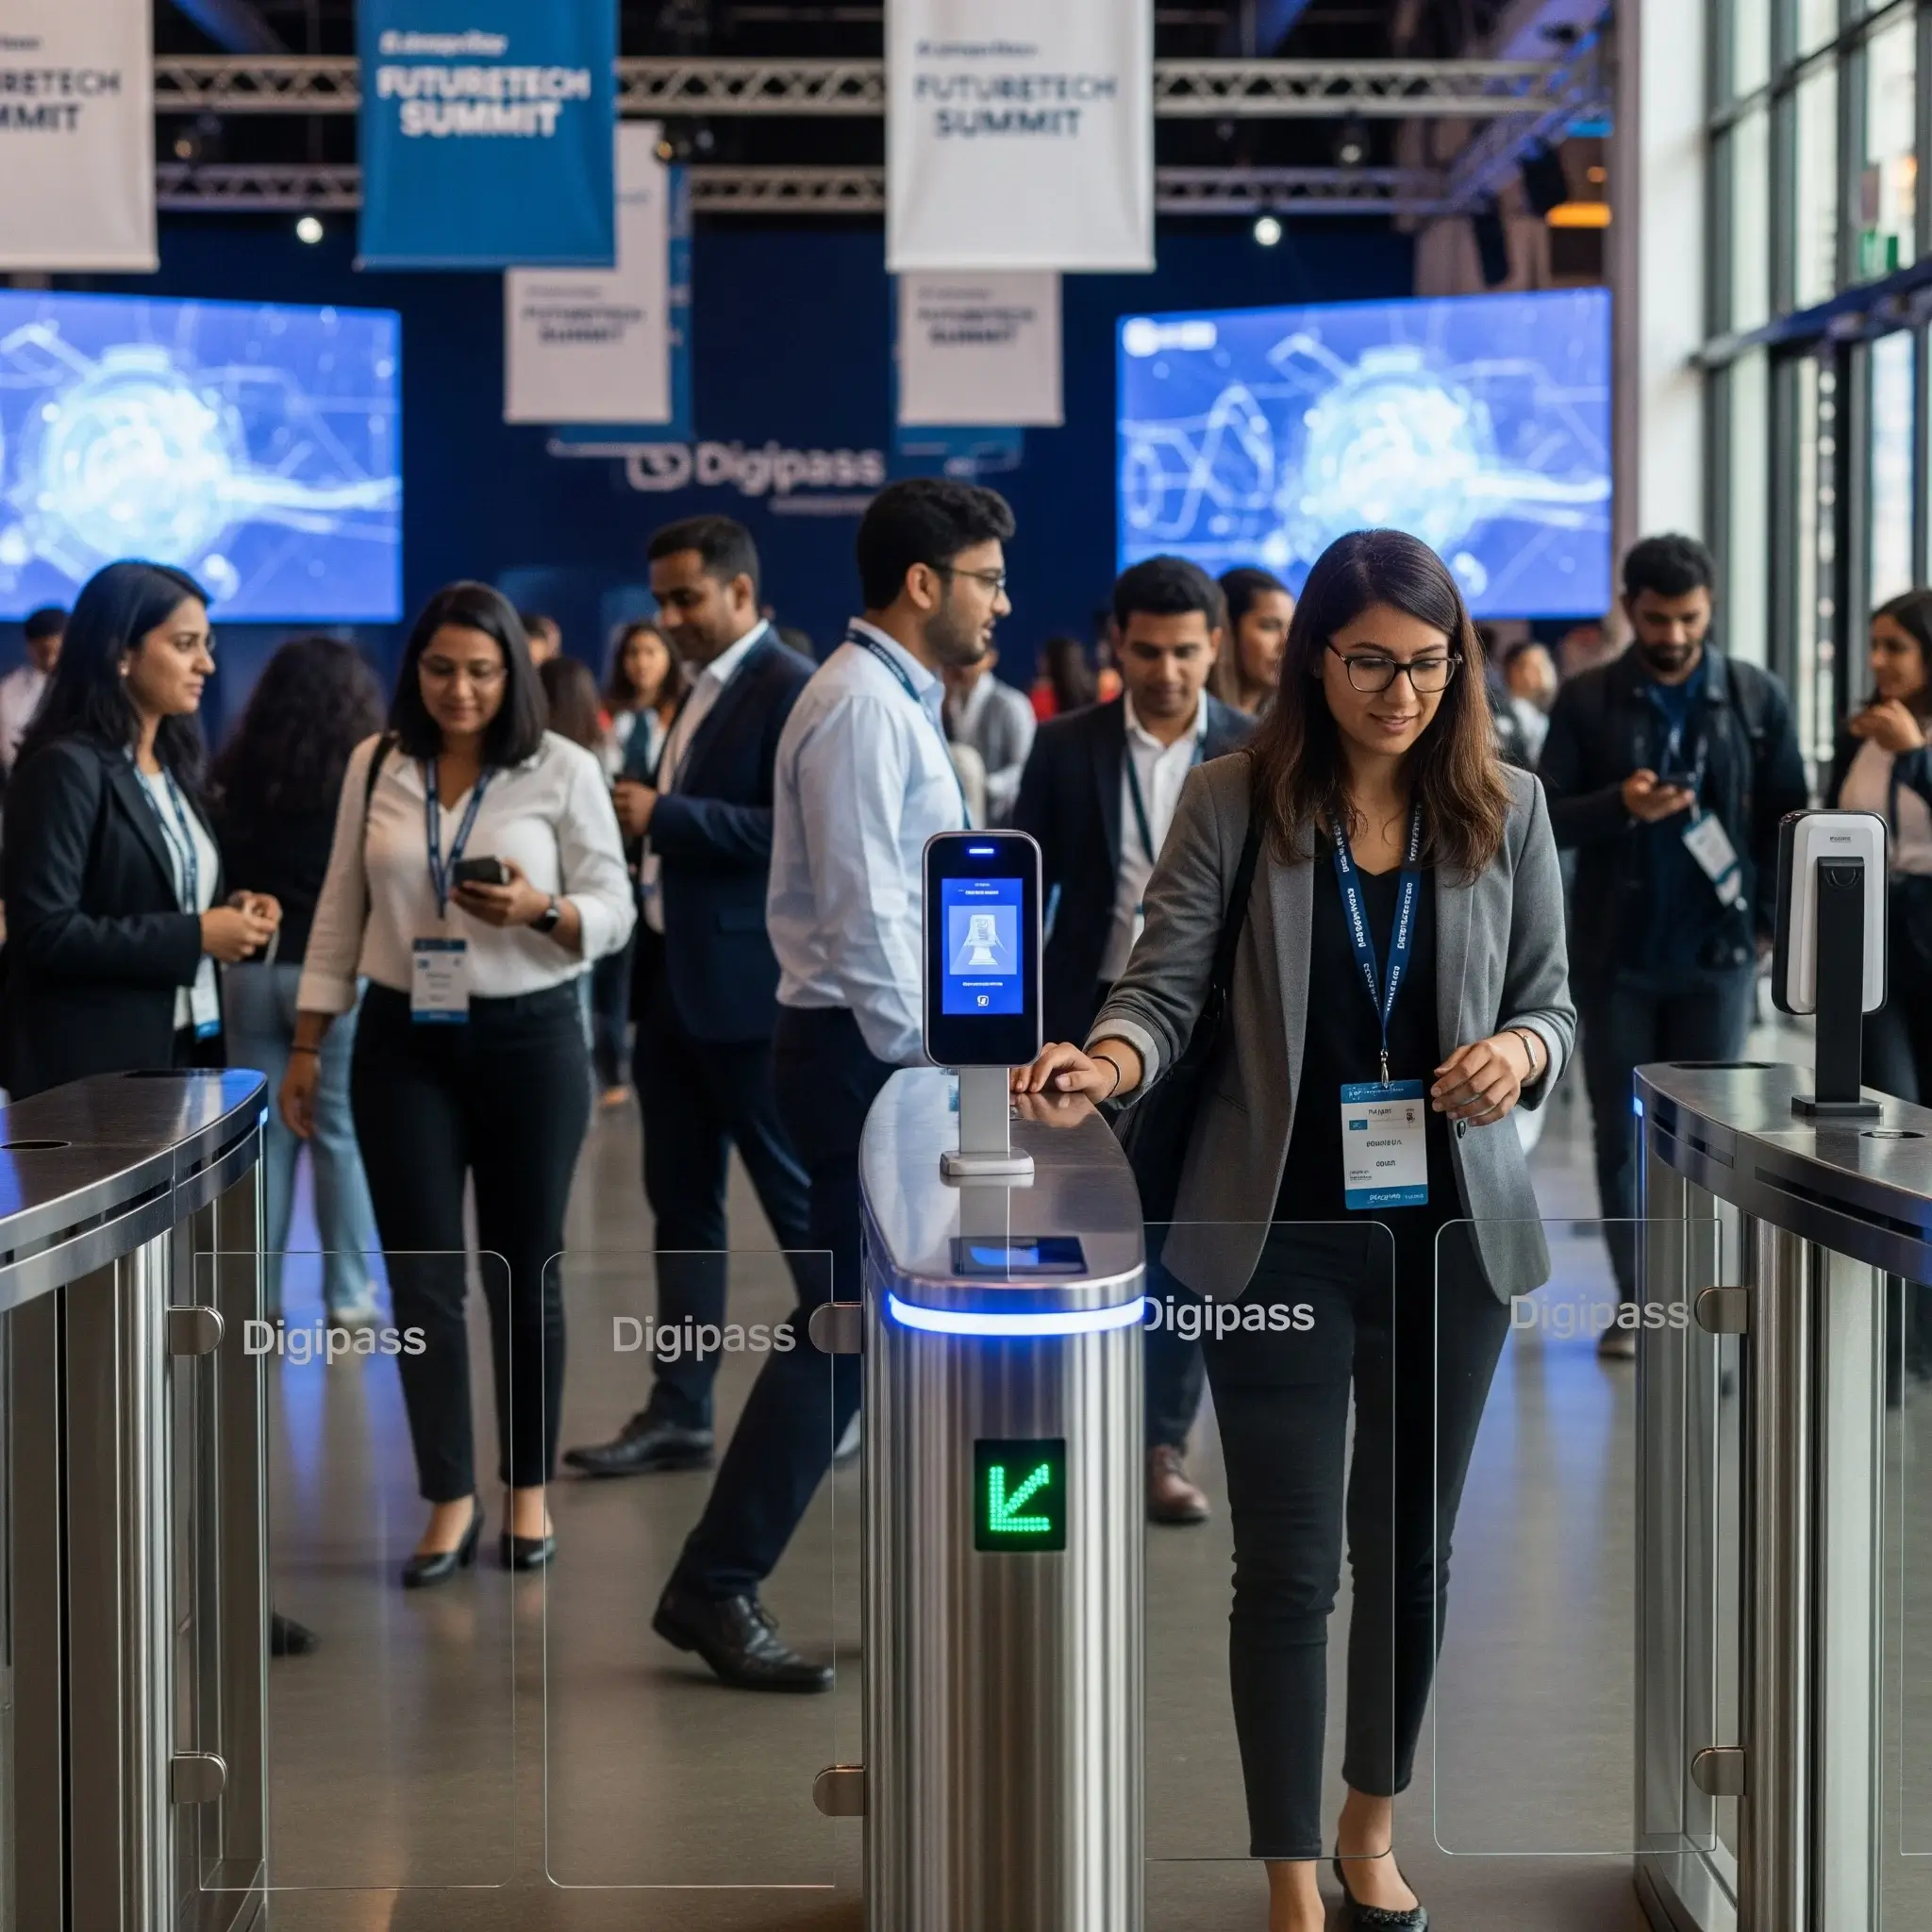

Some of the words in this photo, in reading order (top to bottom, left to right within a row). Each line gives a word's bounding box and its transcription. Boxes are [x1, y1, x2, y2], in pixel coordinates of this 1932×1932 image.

[377, 67, 591, 99] FUTURETECH
[914, 72, 1117, 101] FUTURETECH
[400, 101, 562, 136] SUMMIT
[934, 108, 1082, 138] SUMMIT
[695, 440, 885, 496] Digipass
[1510, 1294, 1689, 1340] Digipass
[243, 1319, 426, 1365] Digipass
[613, 1315, 796, 1362] Digipass
